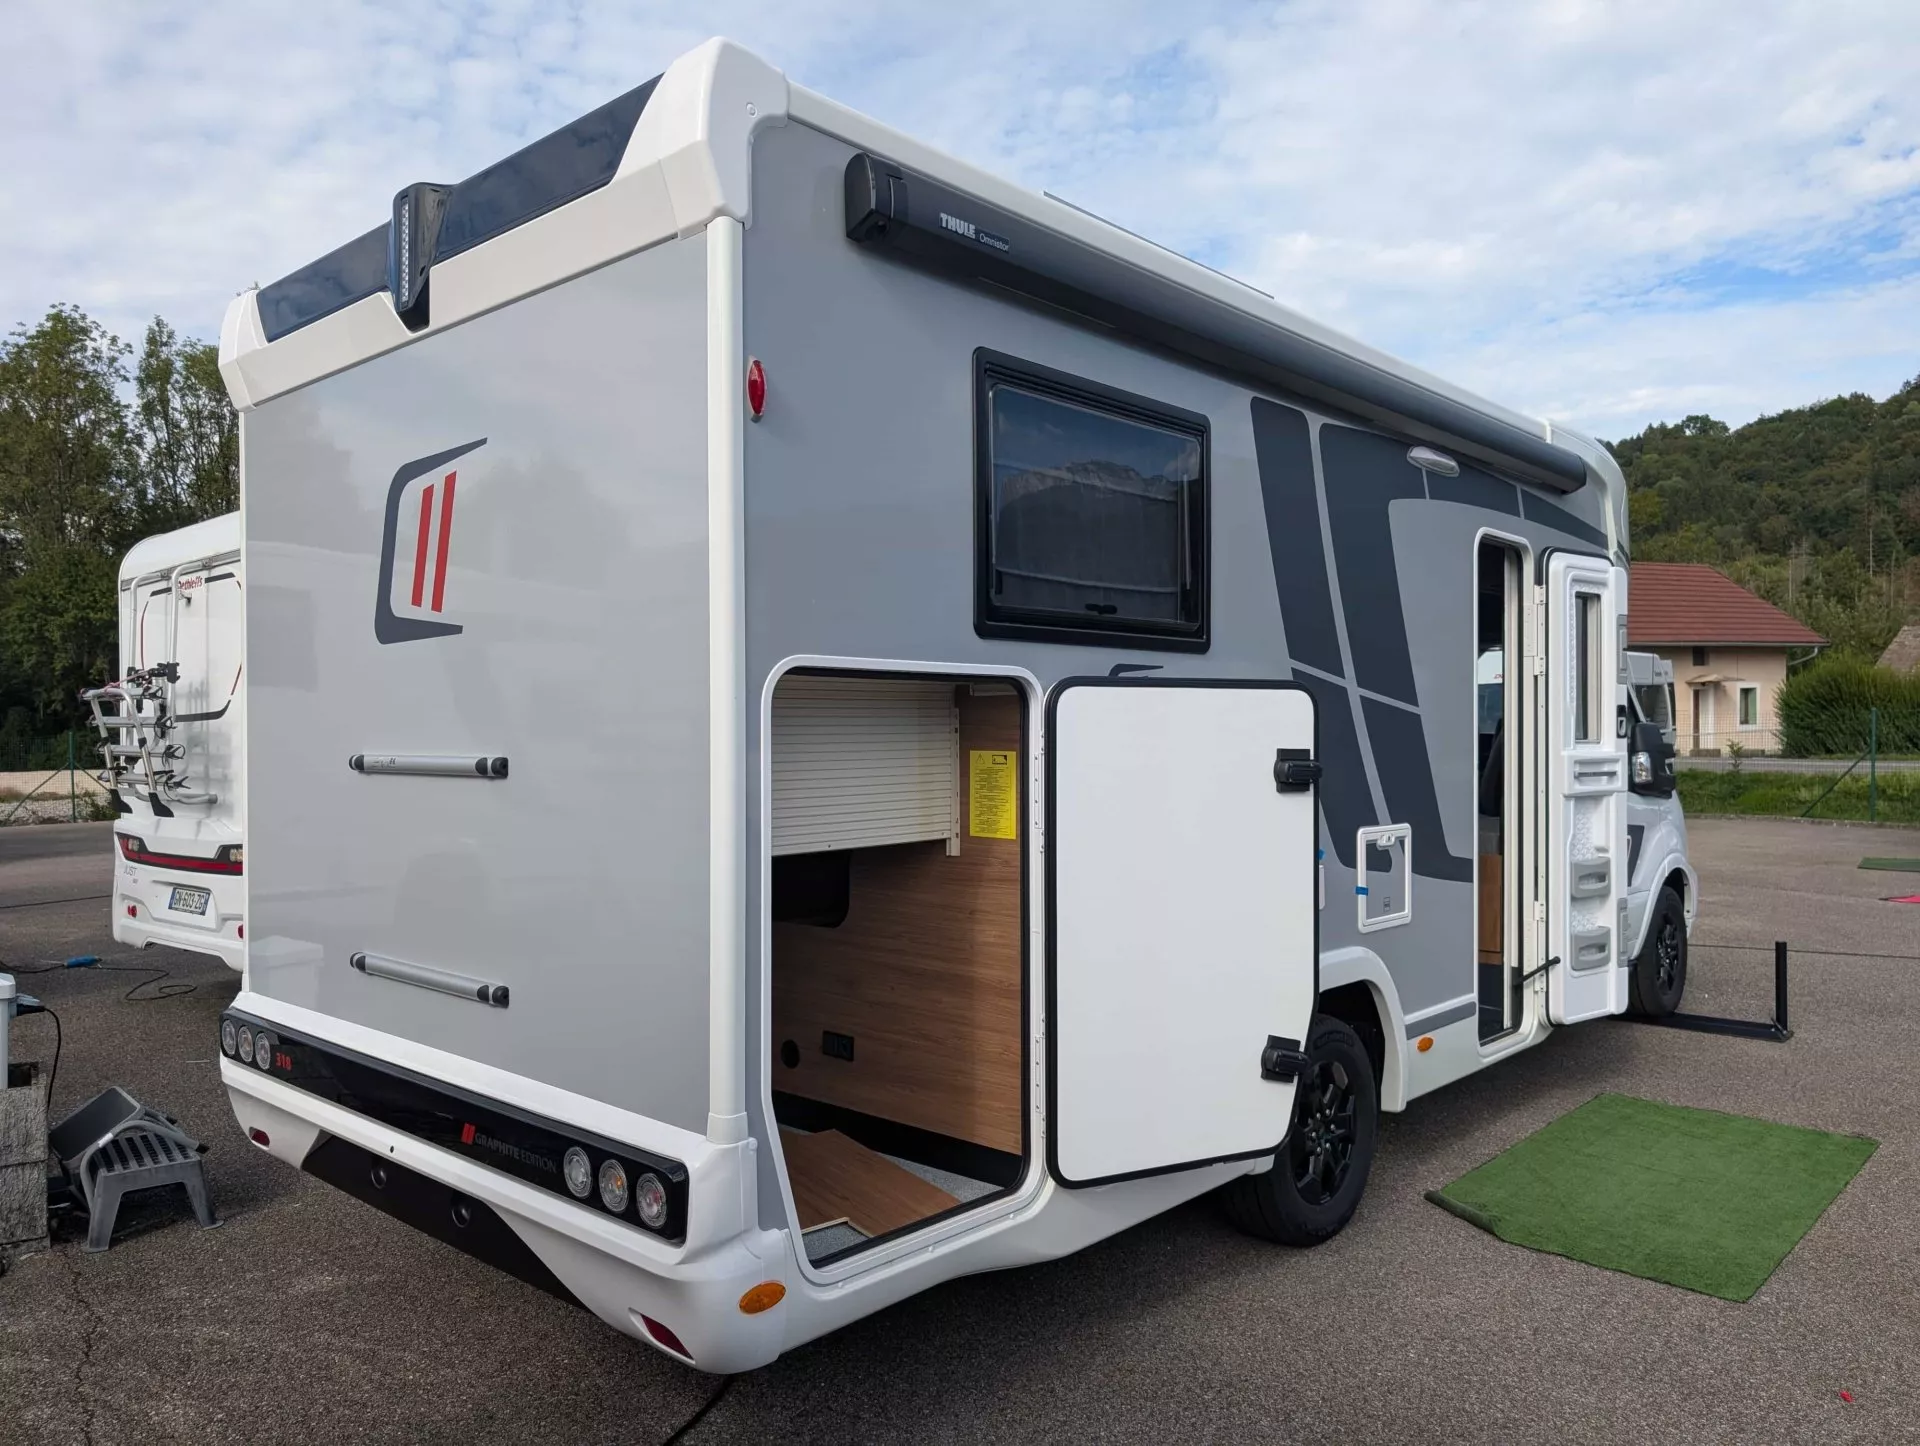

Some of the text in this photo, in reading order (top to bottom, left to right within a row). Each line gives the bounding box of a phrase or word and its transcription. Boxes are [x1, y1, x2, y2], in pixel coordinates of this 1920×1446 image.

[940, 212, 1009, 251] THULE Omnistor
[124, 864, 138, 876] JUST
[475, 1133, 557, 1173] GRAPHITE EDITION
